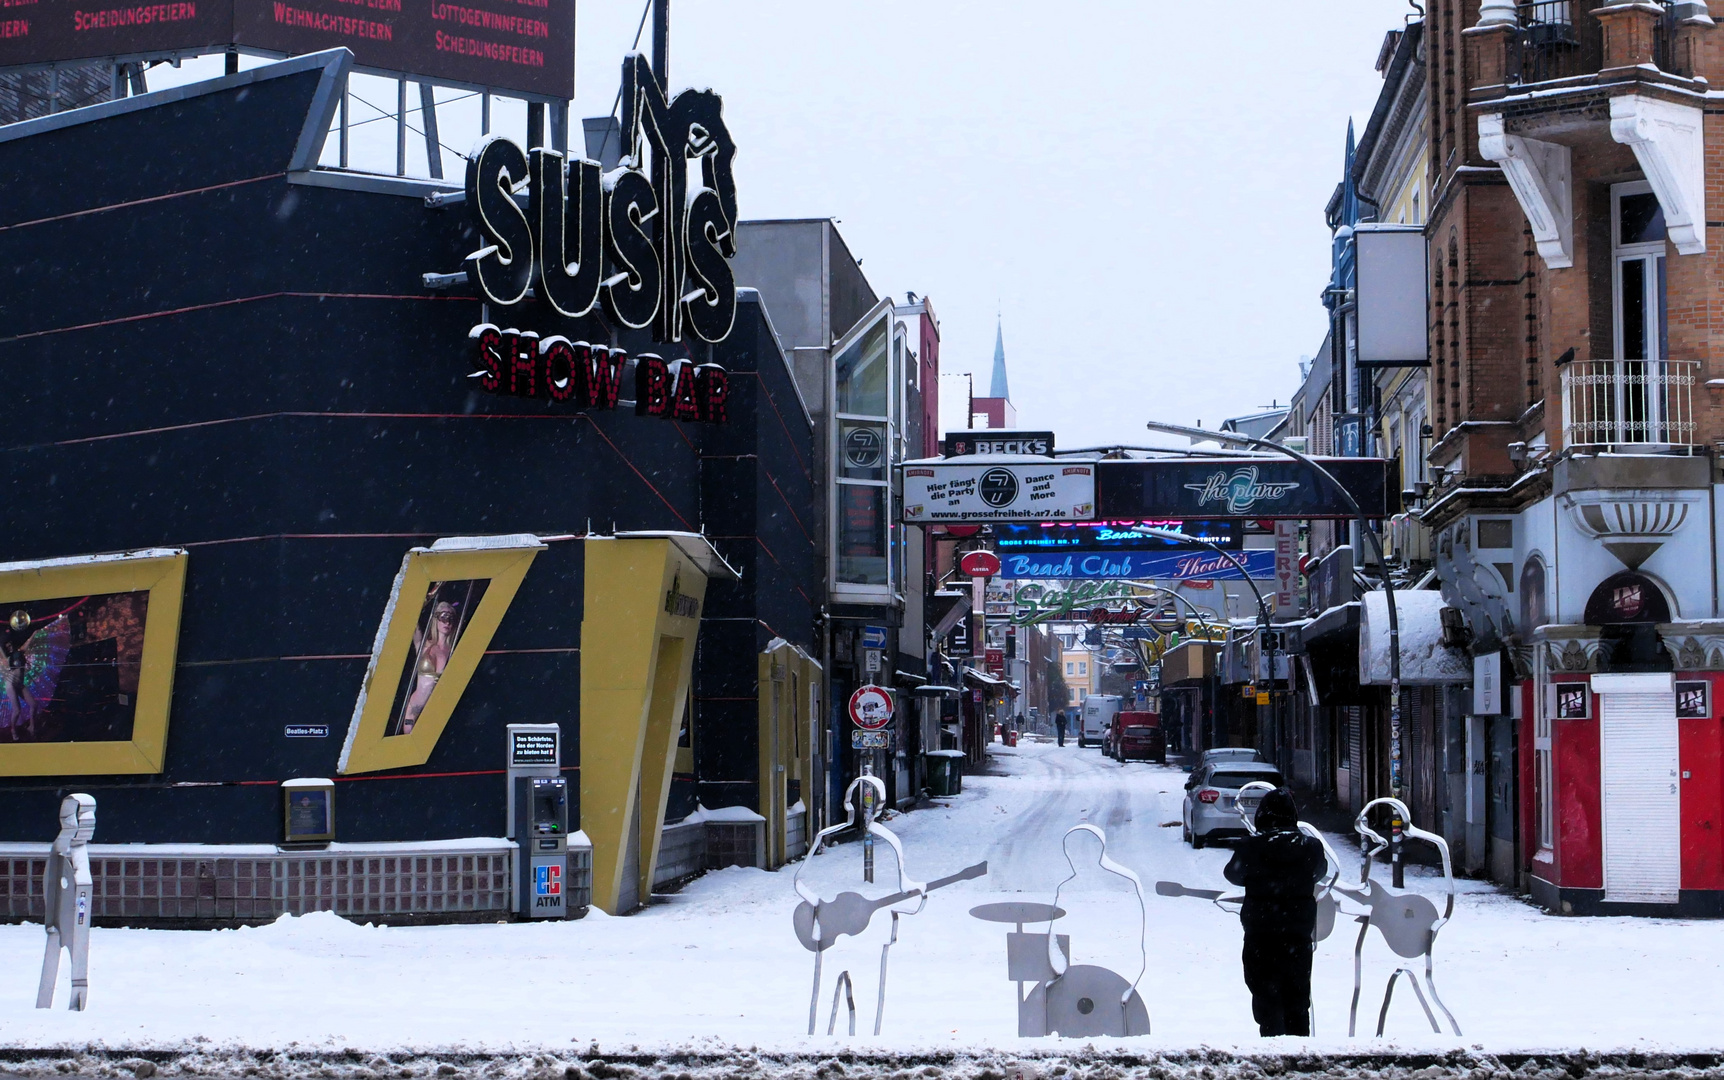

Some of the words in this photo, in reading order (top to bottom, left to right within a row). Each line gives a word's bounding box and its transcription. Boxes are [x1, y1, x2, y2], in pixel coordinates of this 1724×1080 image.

[468, 324, 628, 407] SHOW
[633, 354, 730, 424] BAR
[975, 438, 1047, 455] BECK'S
[926, 483, 948, 493] Hier
[949, 477, 976, 489] fängt
[1025, 473, 1055, 485] Dance
[930, 491, 946, 500] die
[948, 487, 975, 498] Party
[1032, 483, 1051, 492] and
[1199, 471, 1230, 507] the
[1227, 465, 1286, 513] plane
[948, 498, 960, 506] an
[1030, 491, 1056, 501] More
[1008, 555, 1073, 576] Beach
[1080, 555, 1132, 576] Club
[536, 896, 561, 908] ATM
